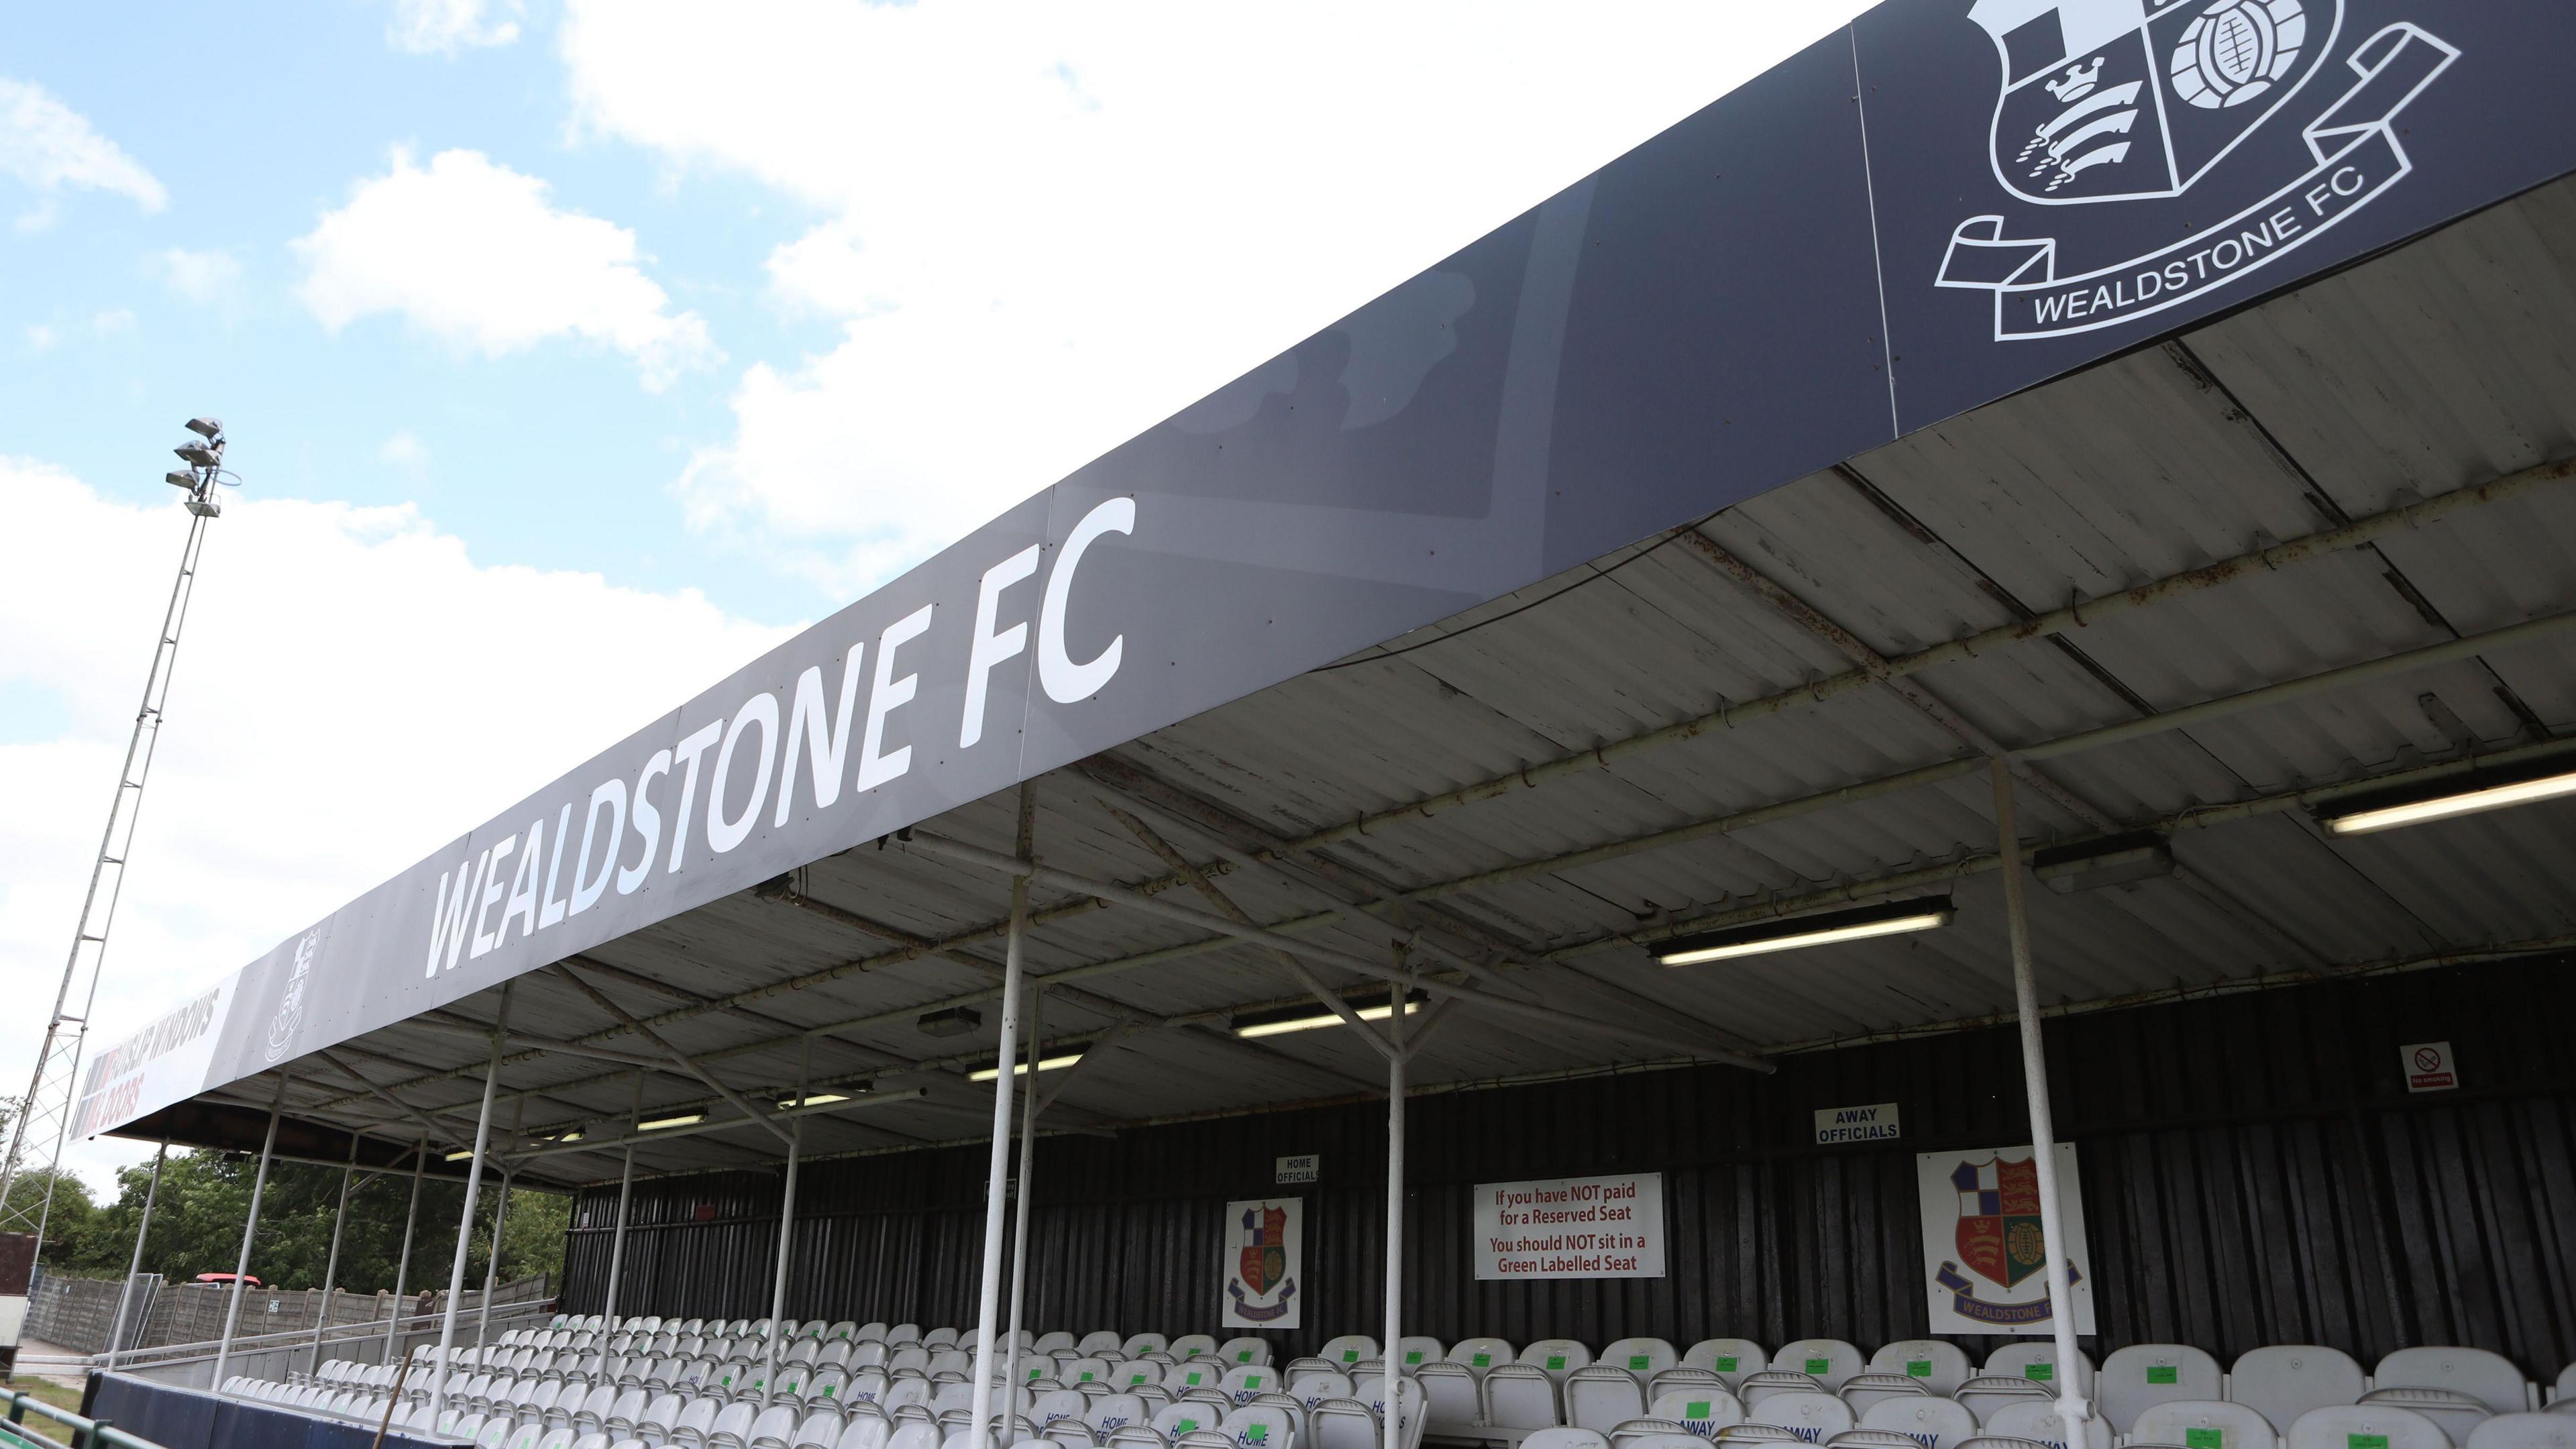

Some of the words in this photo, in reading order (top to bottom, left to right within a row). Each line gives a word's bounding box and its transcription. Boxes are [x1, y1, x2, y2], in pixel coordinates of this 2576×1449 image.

[2035, 207, 2302, 324] WEALDSTONE
[2304, 166, 2365, 216] FC
[425, 603, 933, 979] WEALDSTONE
[959, 497, 1136, 749] FC
[149, 987, 220, 1061] WINDOWS
[2423, 1075, 2451, 1083] smoking
[100, 1072, 145, 1128] DOORS
[1835, 1108, 1877, 1124] AWAY
[1819, 1124, 1897, 1142] OFFICIALS
[1287, 1158, 1311, 1169] HOME
[1277, 1171, 1320, 1182] OFFICIALS
[1495, 1190, 1504, 1205] If
[1507, 1192, 1532, 1208] you
[1536, 1188, 1567, 1203] have
[1571, 1185, 1601, 1201] NOT
[1603, 1181, 1635, 1203] paid
[1500, 1210, 1519, 1225] for
[1521, 1213, 1529, 1224] a
[1533, 1205, 1595, 1224] Reserved
[1600, 1205, 1631, 1221] Seat
[1490, 1238, 1513, 1252] You
[1517, 1235, 1562, 1252] should
[1566, 1234, 1596, 1250] NOT
[1599, 1233, 1615, 1249] sit
[1619, 1233, 1633, 1248] in
[1637, 1236, 1646, 1248] a
[1498, 1258, 1537, 1273] Green
[1541, 1255, 1601, 1272] Labelled
[1604, 1255, 1637, 1271] Seat
[1238, 1304, 1275, 1318] WEALDSTONE
[1277, 1305, 1284, 1314] FC
[1964, 1301, 2041, 1320] WEALDSTONE
[2045, 1303, 2051, 1314] F
[856, 1391, 876, 1403] HOME
[1234, 1390, 1260, 1401] HOM
[1102, 1416, 1128, 1430] HOME
[1784, 1426, 1822, 1443] WAY
